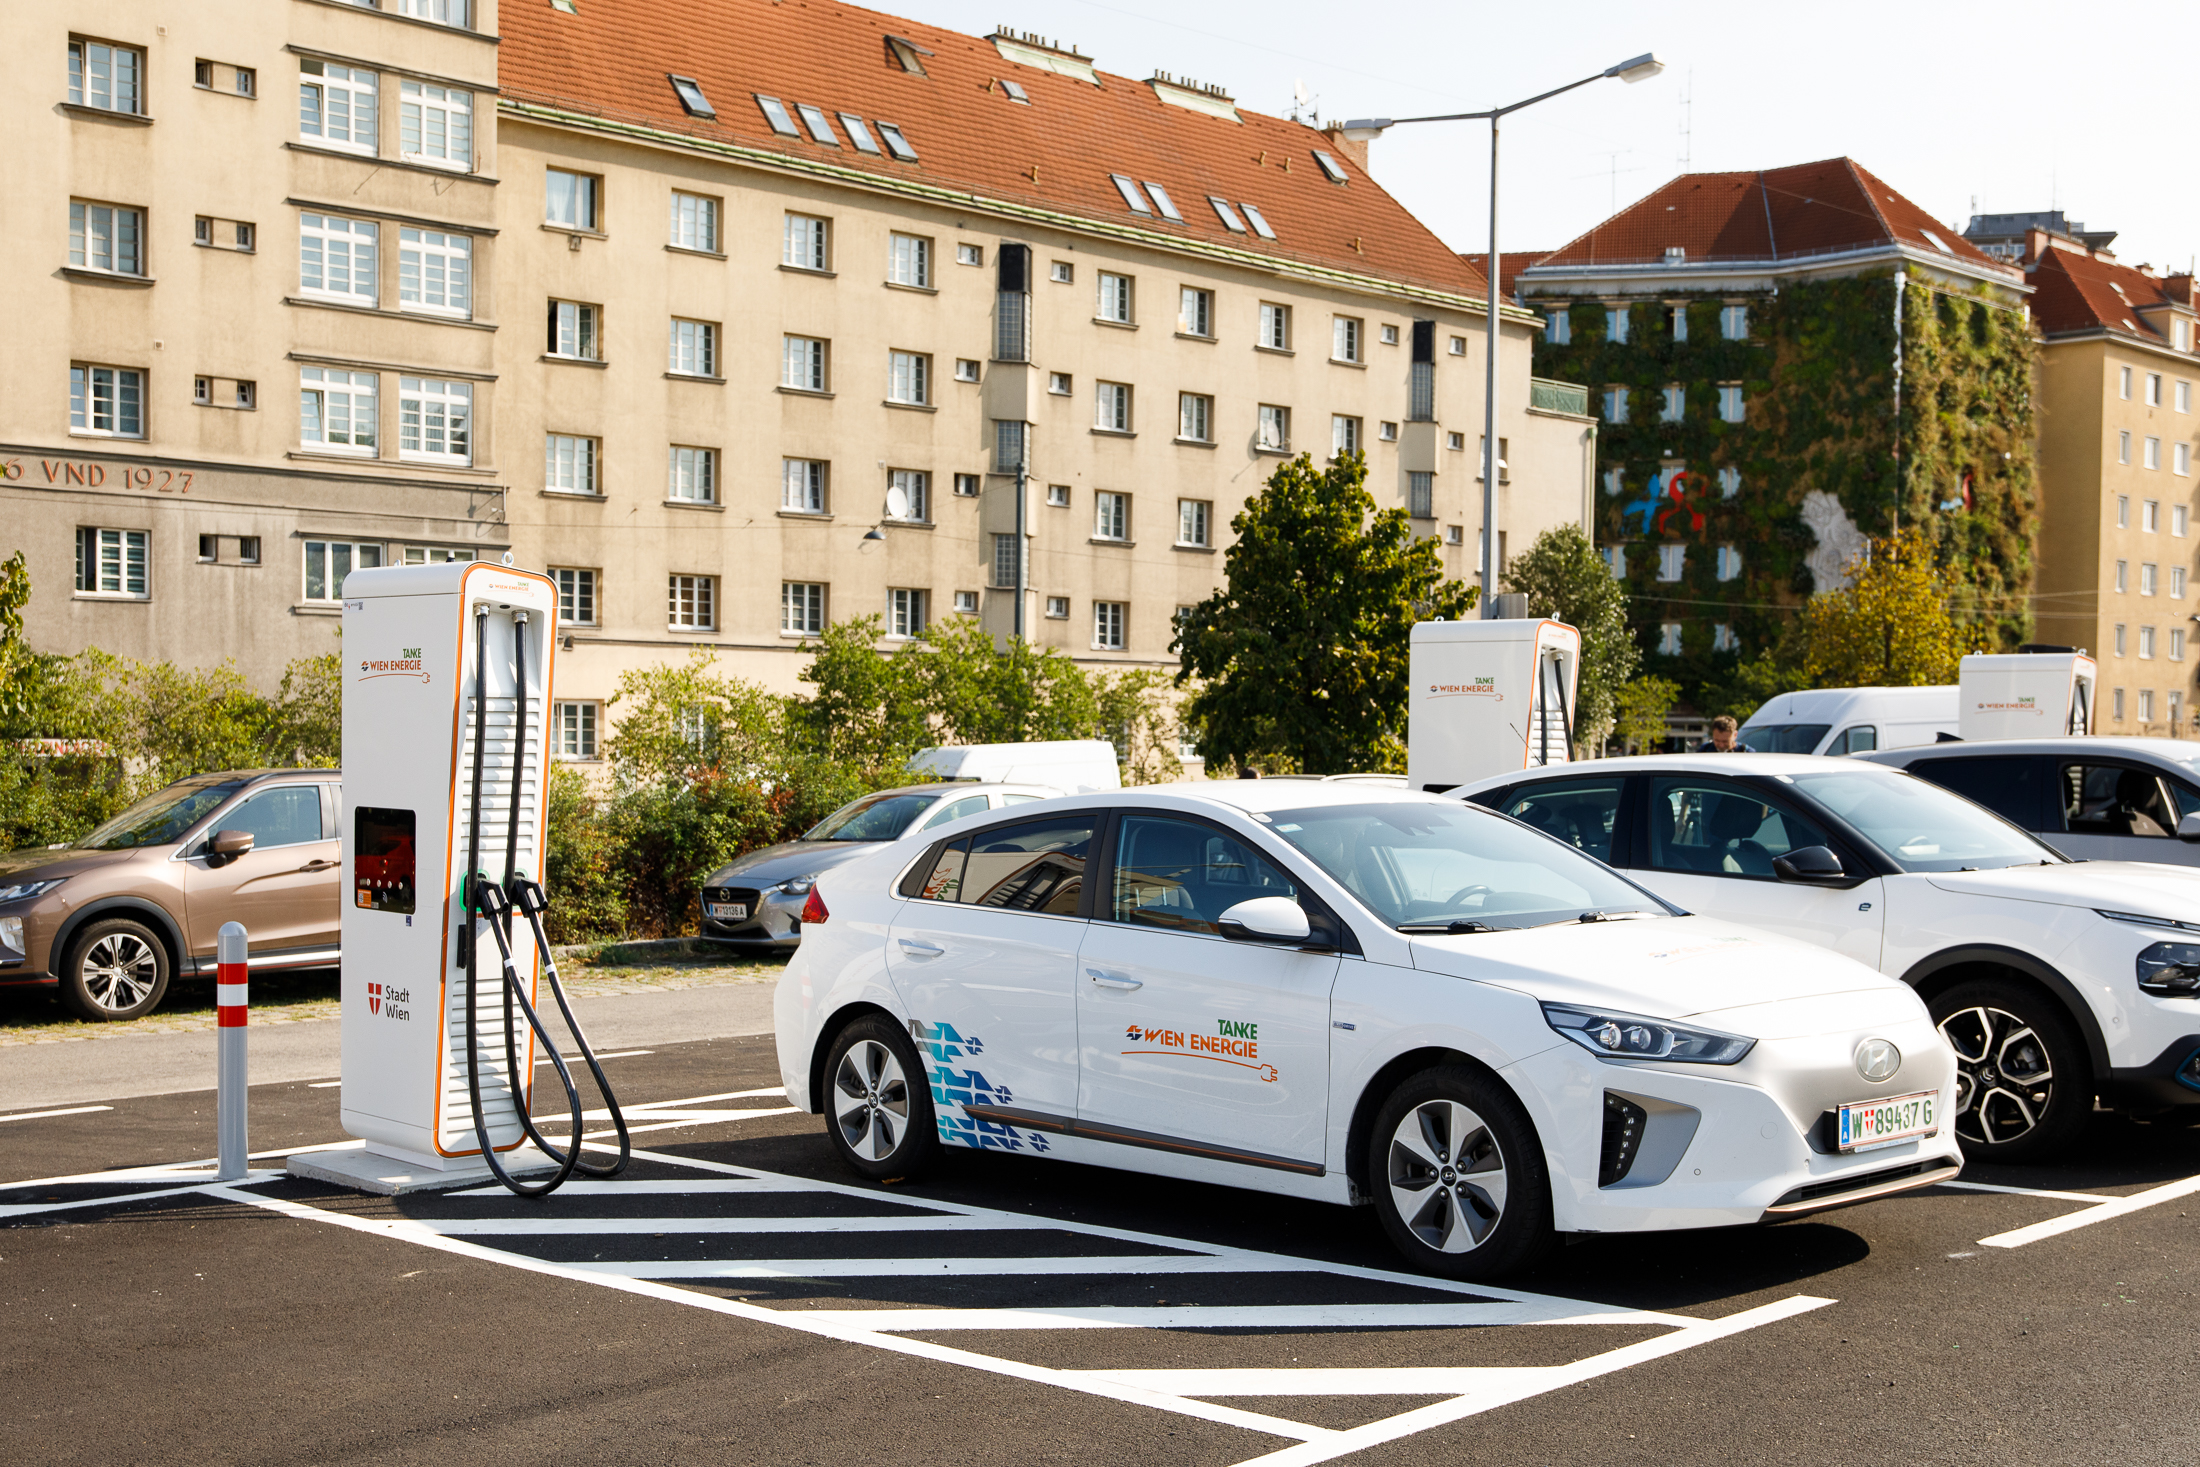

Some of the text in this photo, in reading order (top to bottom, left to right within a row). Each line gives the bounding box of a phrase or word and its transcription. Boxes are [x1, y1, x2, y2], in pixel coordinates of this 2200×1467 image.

[42, 459, 107, 487] VND
[124, 466, 195, 494] 1927
[403, 648, 422, 659] TANKE
[370, 660, 422, 671] WIEN ENERGIE
[1461, 685, 1494, 693] ENERGIE
[1475, 677, 1494, 685] TANKE
[386, 985, 410, 1004] Stadt
[386, 1002, 410, 1022] Wien
[1217, 1019, 1258, 1040] TANKE
[1144, 1027, 1258, 1059] WIEN ENERGIE
[1852, 1099, 1932, 1139] W 89437 G
